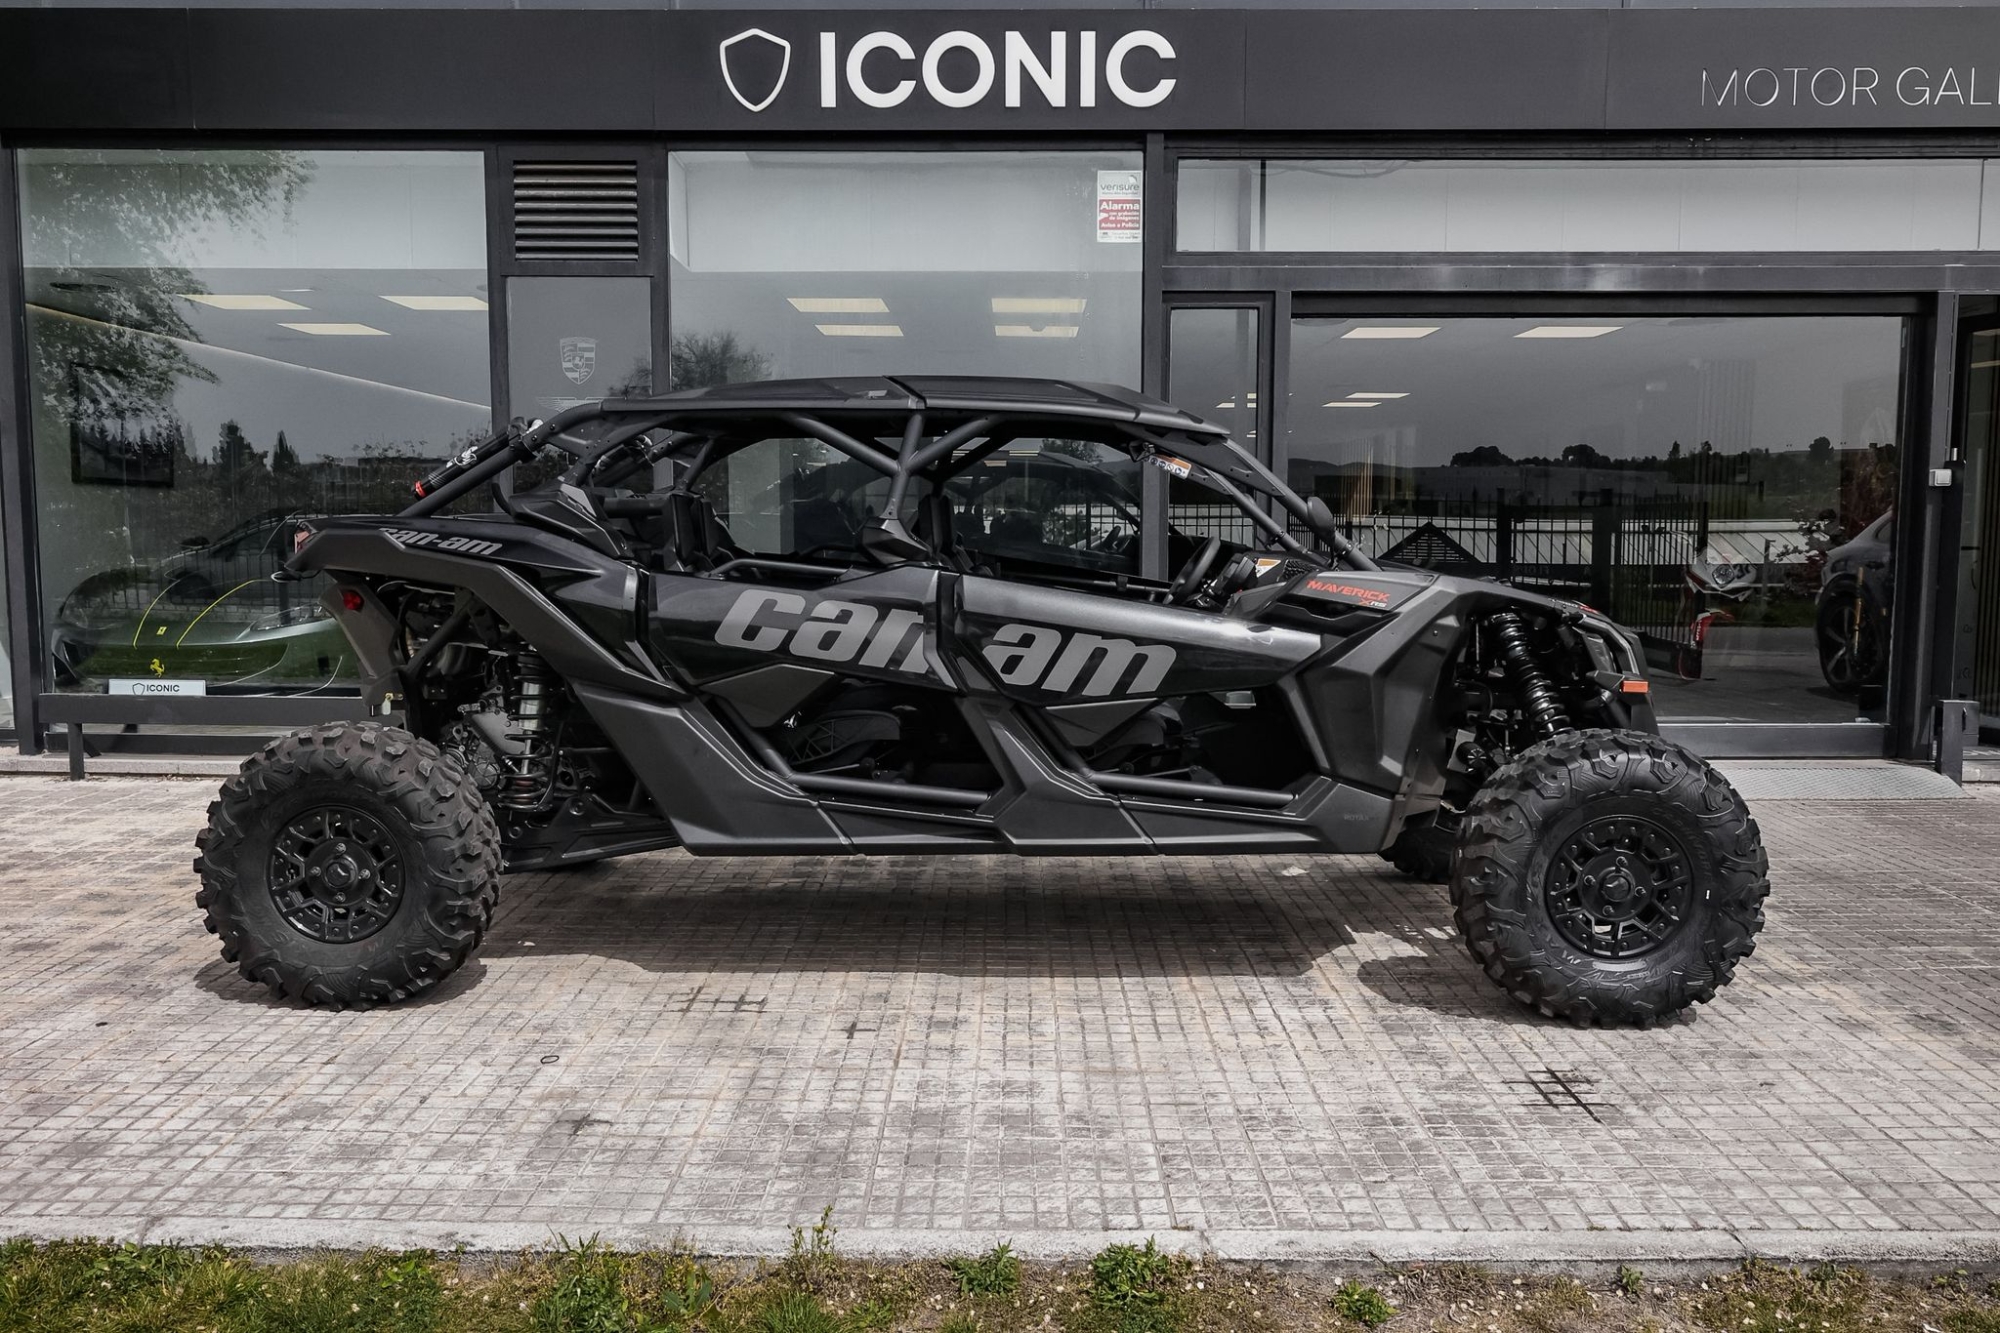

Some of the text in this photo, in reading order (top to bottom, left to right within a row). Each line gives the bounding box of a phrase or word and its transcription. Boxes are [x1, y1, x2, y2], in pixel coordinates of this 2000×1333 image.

[820, 29, 1177, 108] ICONIC
[1701, 66, 2000, 107] MOTOR GAL
[1100, 183, 1140, 191] verisure
[1100, 200, 1140, 210] Alarma
[1306, 579, 1391, 602] MAVERICK
[146, 684, 180, 693] ICONIC
